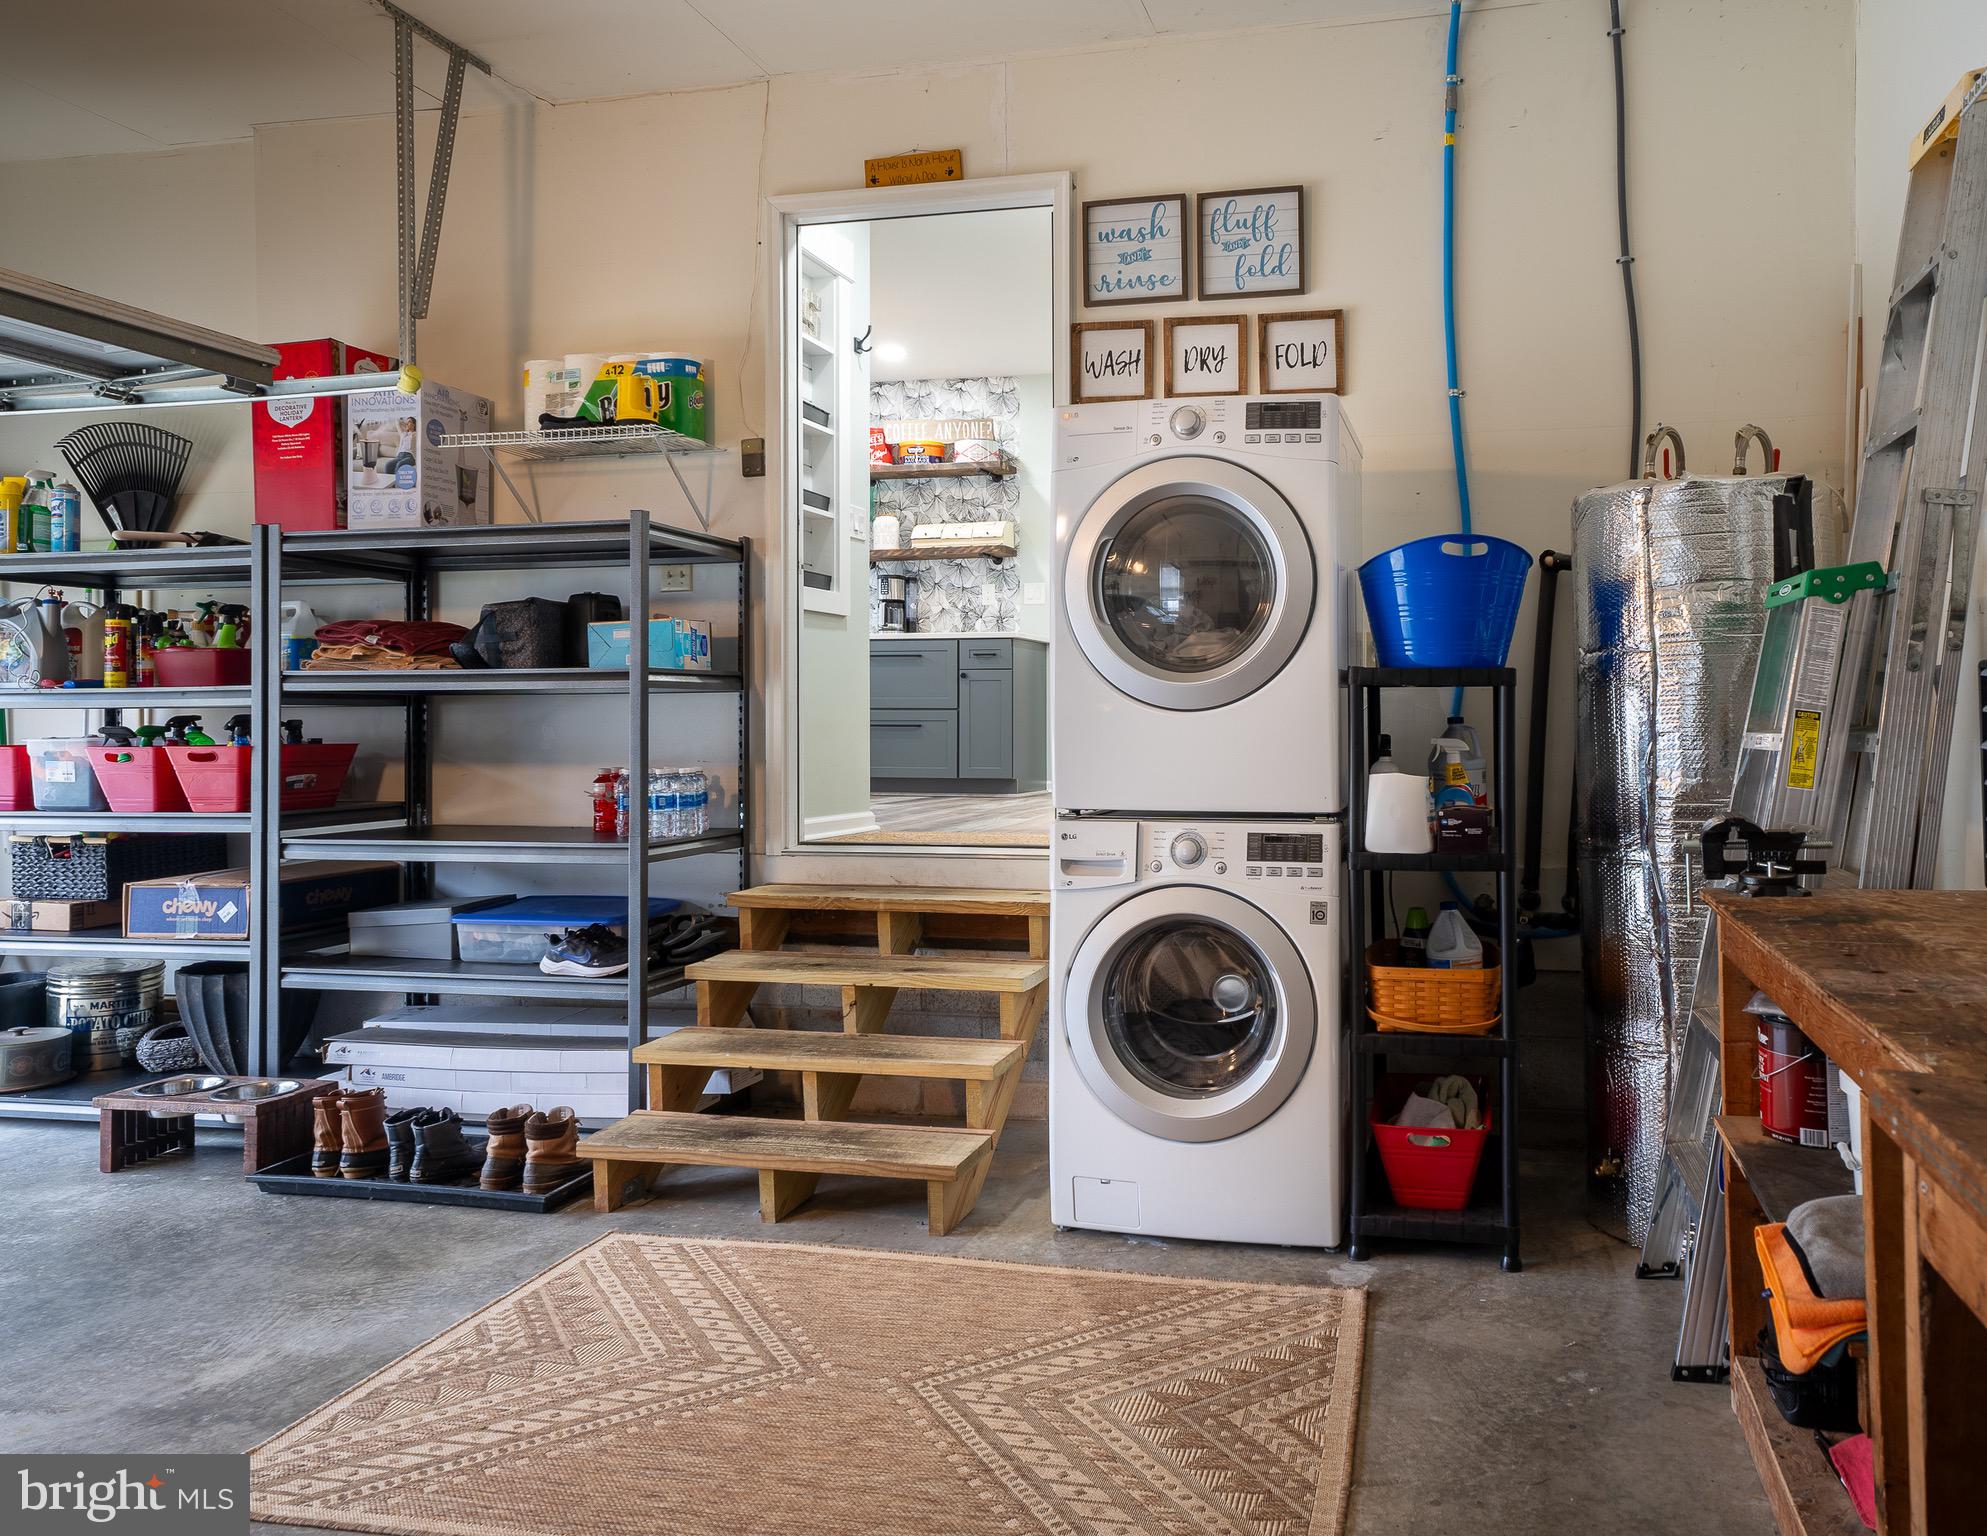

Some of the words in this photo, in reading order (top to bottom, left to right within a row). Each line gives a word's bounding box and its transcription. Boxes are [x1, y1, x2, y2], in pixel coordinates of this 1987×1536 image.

[1098, 202, 1171, 244] wash
[1210, 199, 1279, 245] fluff
[1234, 243, 1293, 290] fold
[1094, 270, 1177, 293] rinse
[1084, 349, 1142, 379] WASH
[1184, 345, 1228, 374] DRY
[1274, 341, 1328, 370] FOLD
[274, 403, 307, 412] DECORATIVE
[351, 395, 417, 408] INNOVATIONS
[935, 421, 993, 441] ANYONE?
[162, 897, 218, 918] chewy
[70, 1014, 121, 1032] POTATO
[381, 1072, 407, 1082] AMBRIDGE
